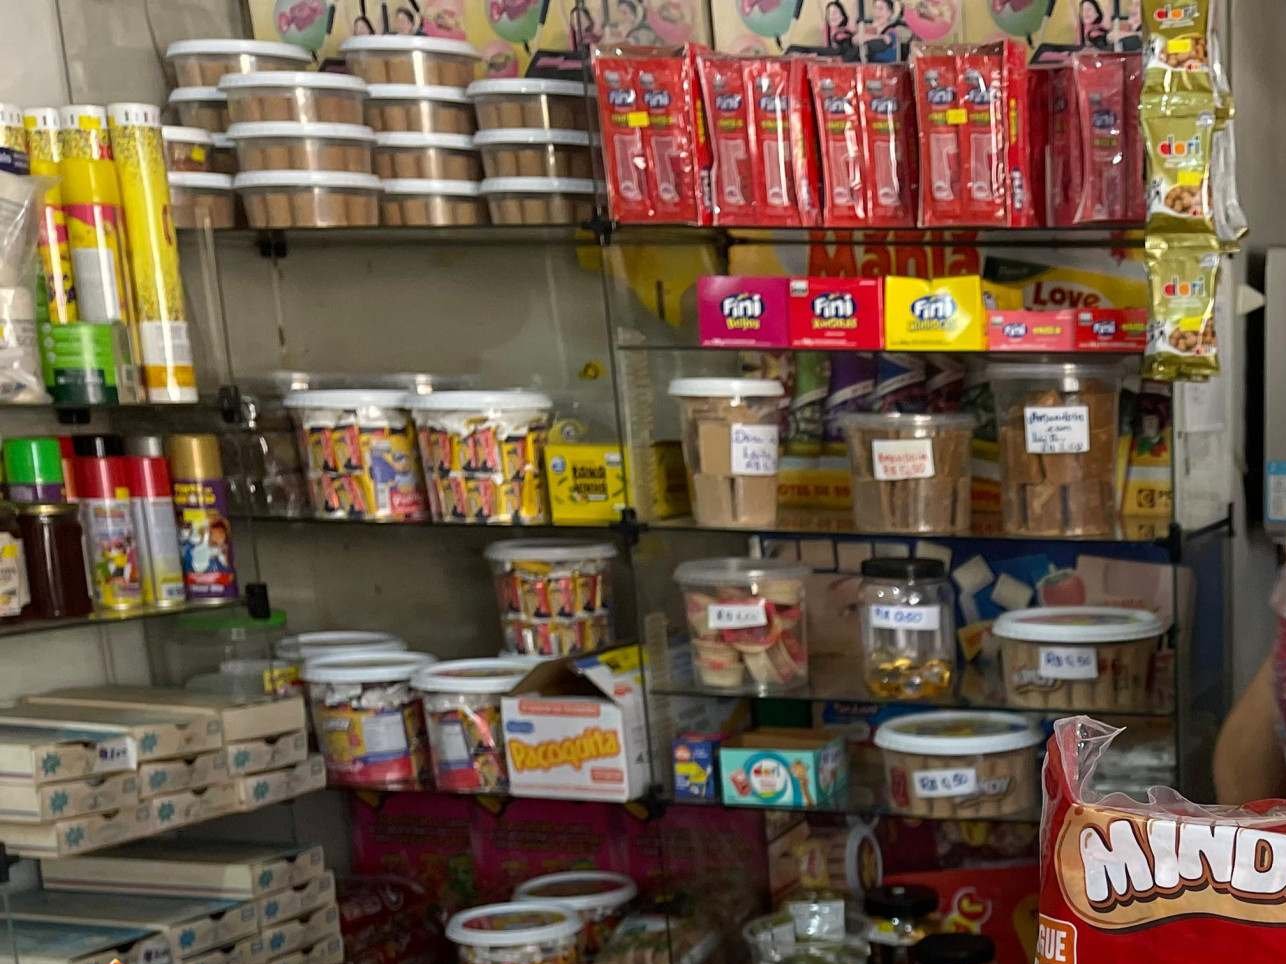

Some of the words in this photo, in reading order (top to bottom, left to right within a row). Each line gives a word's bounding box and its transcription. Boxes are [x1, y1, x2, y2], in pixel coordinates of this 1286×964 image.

[1159, 136, 1201, 156] dori
[1162, 276, 1205, 297] dori
[722, 293, 762, 318] Fini
[813, 293, 854, 318] Fini
[912, 297, 955, 321] Fini
